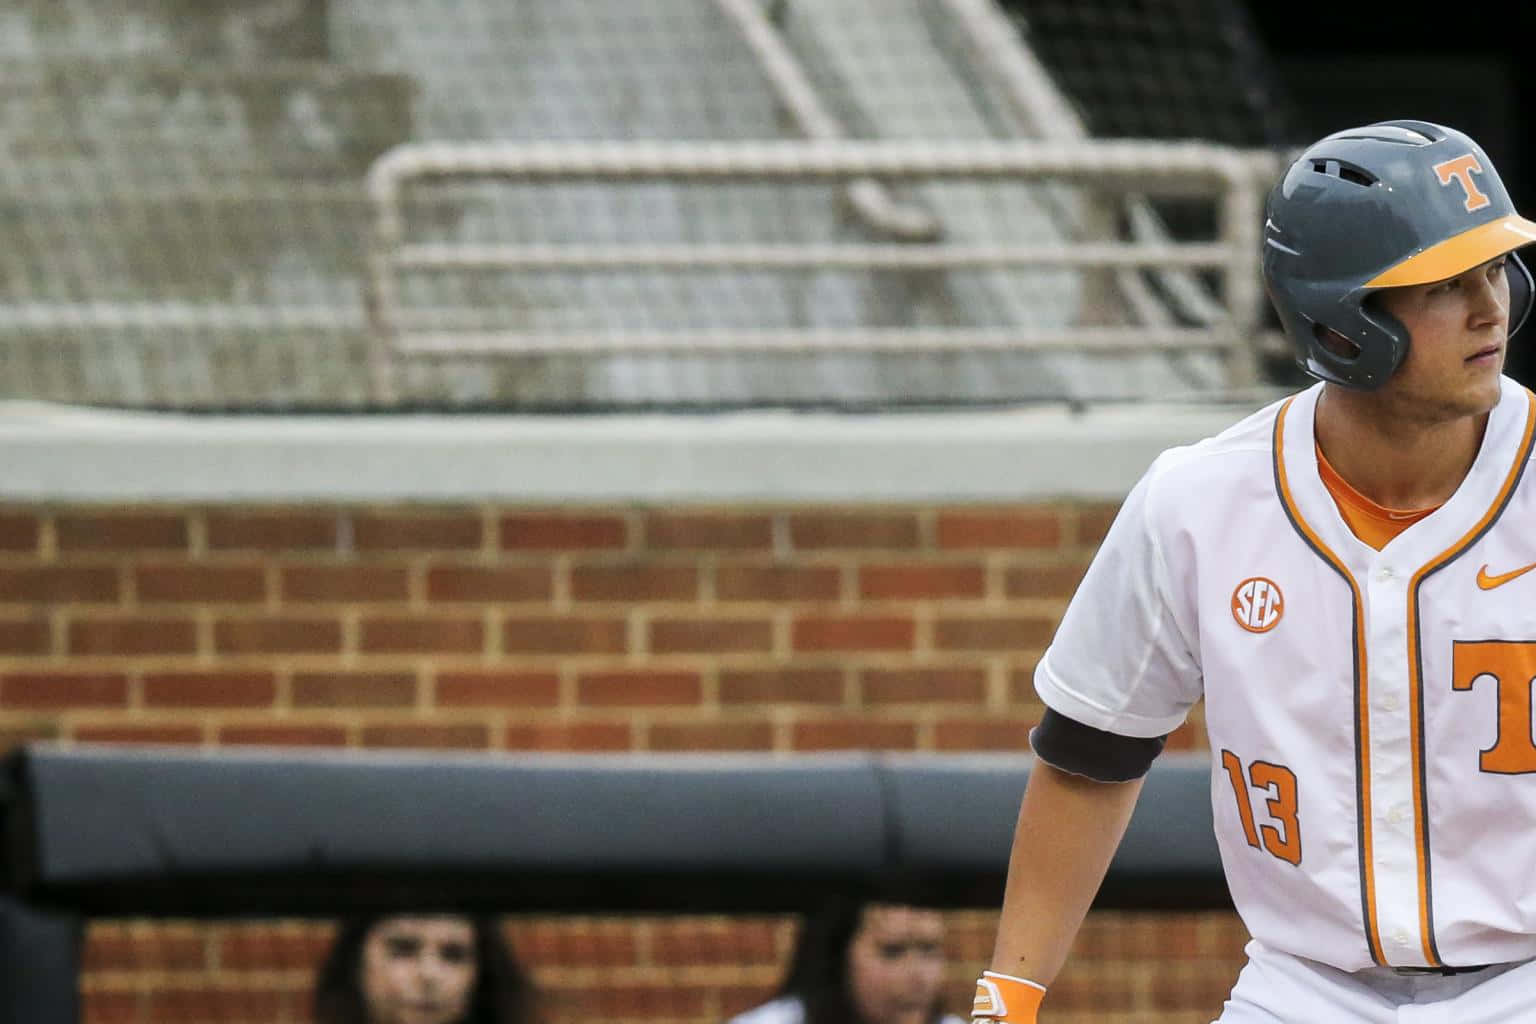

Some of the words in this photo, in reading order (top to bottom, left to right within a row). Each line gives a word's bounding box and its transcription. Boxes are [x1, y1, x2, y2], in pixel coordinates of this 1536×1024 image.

[1432, 153, 1490, 213] T
[1236, 580, 1281, 629] SEC
[1221, 749, 1302, 866] 13
